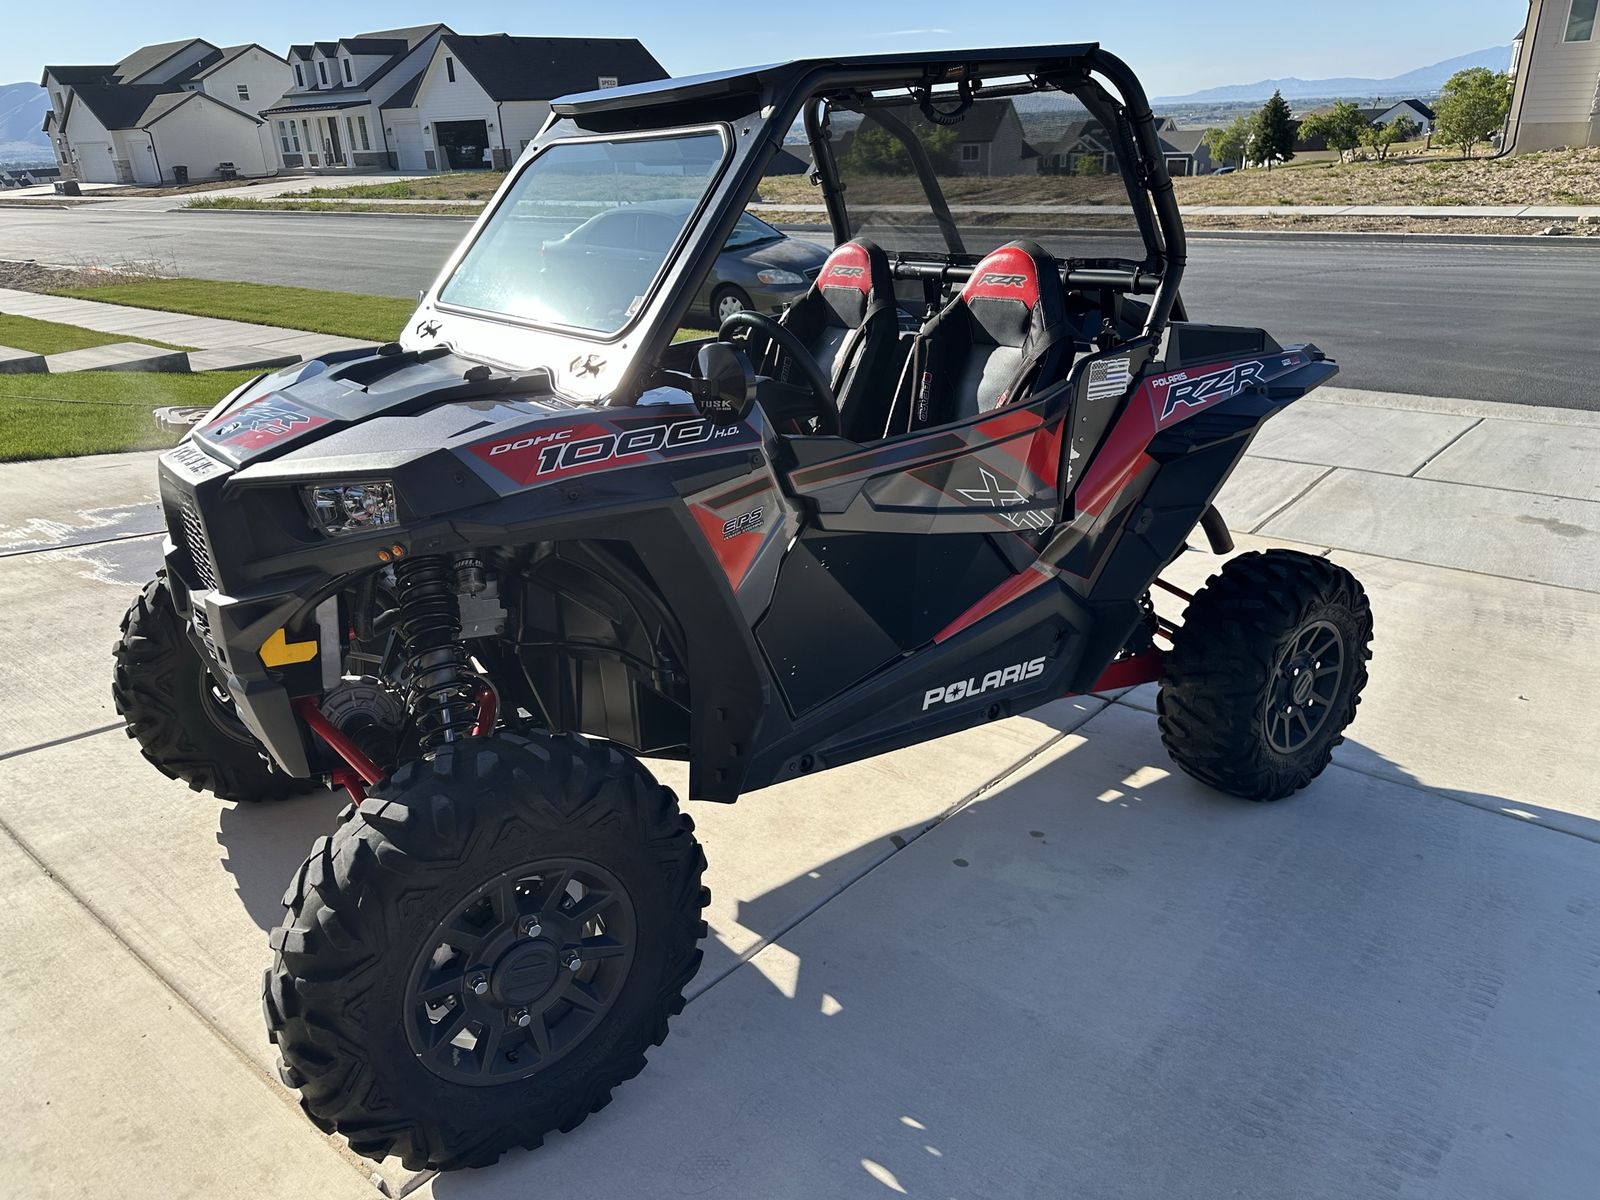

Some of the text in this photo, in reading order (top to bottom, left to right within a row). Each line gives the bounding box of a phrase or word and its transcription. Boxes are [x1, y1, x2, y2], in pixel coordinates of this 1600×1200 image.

[828, 266, 865, 279] RZR
[977, 273, 1028, 289] RZR
[1152, 372, 1187, 388] POLARIS
[1160, 360, 1265, 422] RZR
[700, 400, 732, 408] TUSK
[489, 429, 574, 456] DOHC
[536, 418, 715, 475] 1000
[722, 506, 764, 535] EPS
[922, 656, 1046, 711] POLARIS
